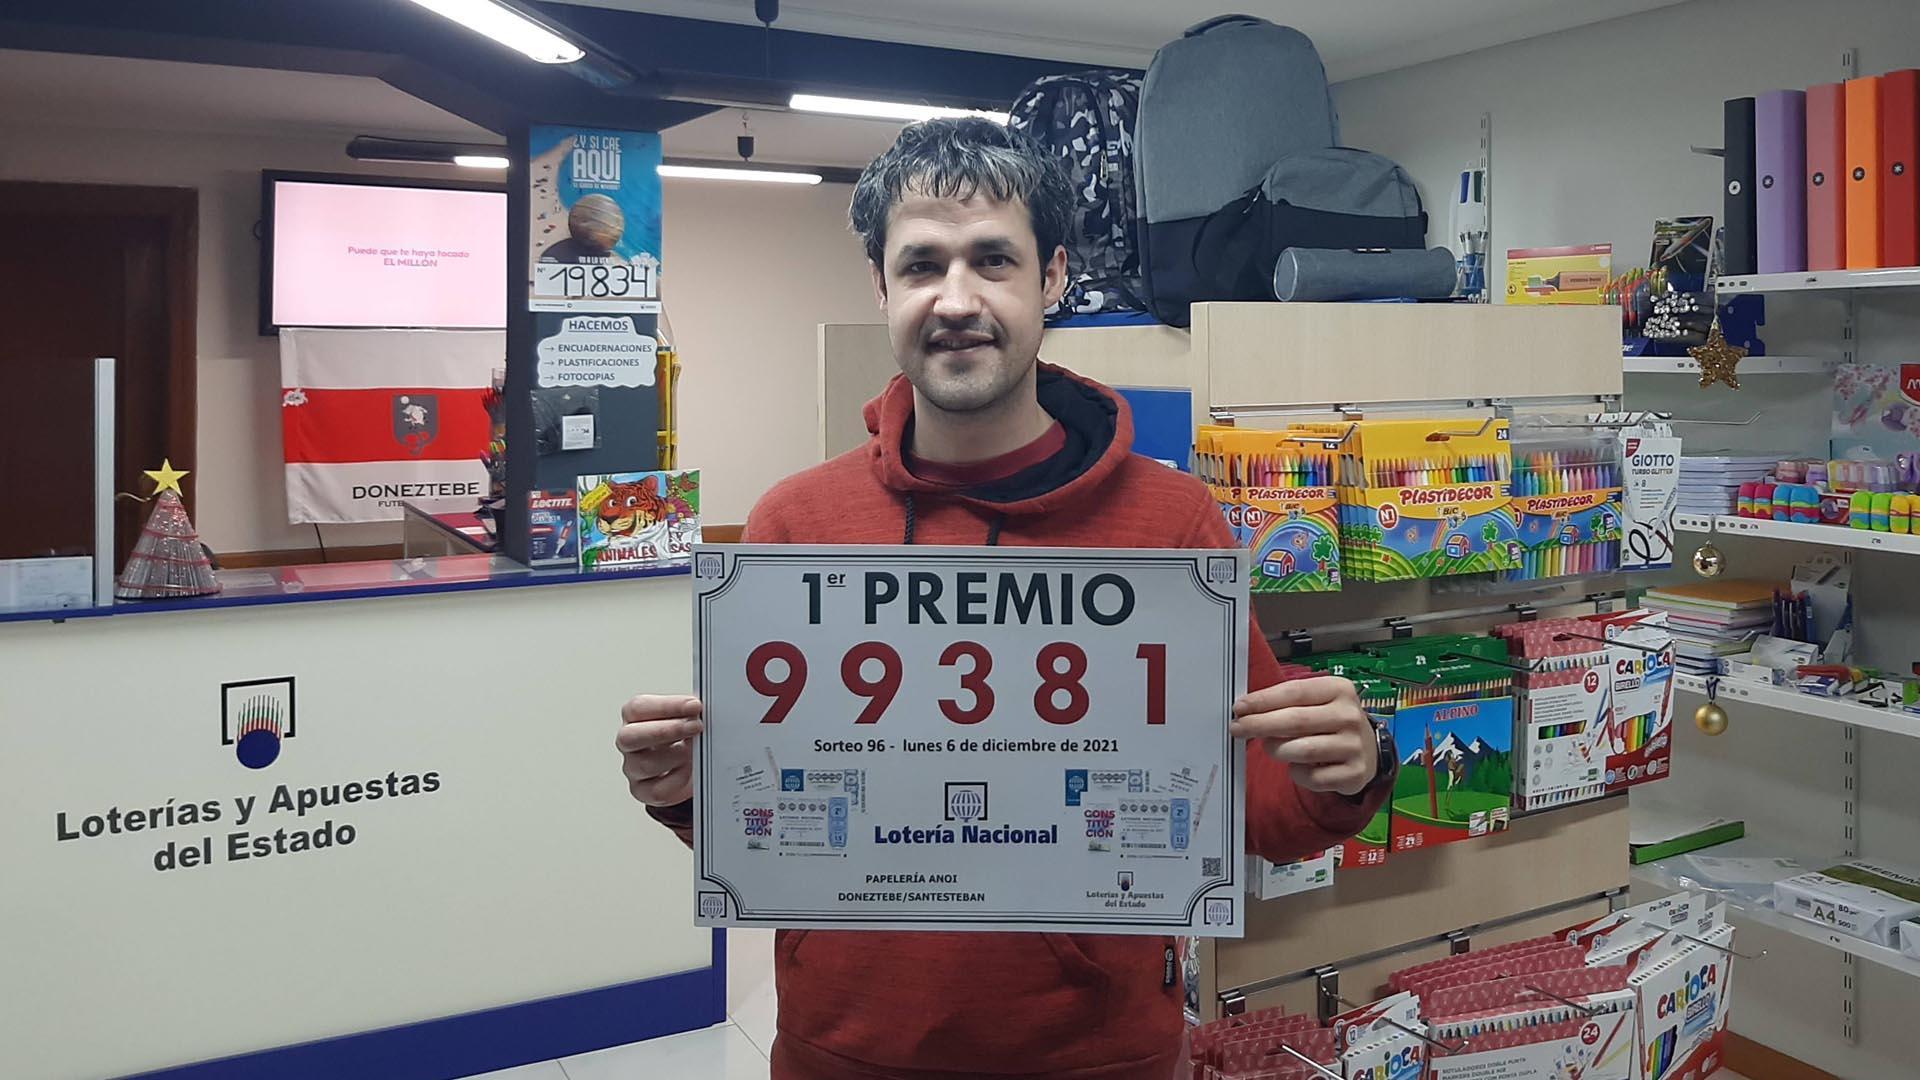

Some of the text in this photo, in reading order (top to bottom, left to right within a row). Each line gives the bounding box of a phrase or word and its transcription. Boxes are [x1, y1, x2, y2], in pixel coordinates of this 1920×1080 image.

[590, 135, 600, 149] SI
[602, 136, 620, 150] CAE
[573, 148, 622, 182] AQUÍ
[380, 248, 398, 256] que
[400, 248, 409, 256] te
[412, 248, 435, 258] haya
[438, 249, 470, 258] tocado
[384, 258, 395, 266] EL
[569, 320, 629, 332] HACEMOS
[558, 344, 652, 353] ENCUADERNACIONES
[558, 358, 640, 367] PLASTIFICACIONES
[558, 372, 615, 381] FOTOCOPIAS
[1497, 430, 1508, 440] 24
[1632, 454, 1675, 467] GIOTTO
[352, 482, 480, 499] DONEZTEBE
[531, 498, 573, 509] LOCTITE
[1443, 507, 1459, 515] BIC
[597, 543, 657, 562] ANIMALES
[864, 571, 1136, 626] PREMIO
[1415, 655, 1427, 665] 24
[1333, 664, 1344, 675] 12
[1586, 675, 1597, 687] 12
[1434, 703, 1479, 722] ALPINO
[814, 738, 863, 752] Sorteo
[867, 739, 886, 752] 96
[903, 738, 944, 752] lunes
[946, 739, 956, 752] 6
[959, 739, 978, 752] de
[982, 738, 1056, 752] diciembre
[1060, 739, 1079, 752] de
[1082, 739, 1119, 752] 2021
[56, 770, 441, 841] Loterías y Apuestas
[742, 807, 774, 817] CONS
[1084, 809, 1116, 819] CONS
[874, 824, 1058, 844] Lotería Nacional
[153, 819, 357, 872] del Estado
[865, 871, 958, 884] PAPELERÍA ANOI
[838, 891, 985, 903] DONEZTEBE/SANTESTEBAN
[1127, 891, 1165, 900] Apuestas
[1104, 900, 1147, 908] del Estado
[1813, 906, 1837, 924] A4
[1838, 919, 1851, 929] 500
[1582, 1026, 1599, 1039] 24
